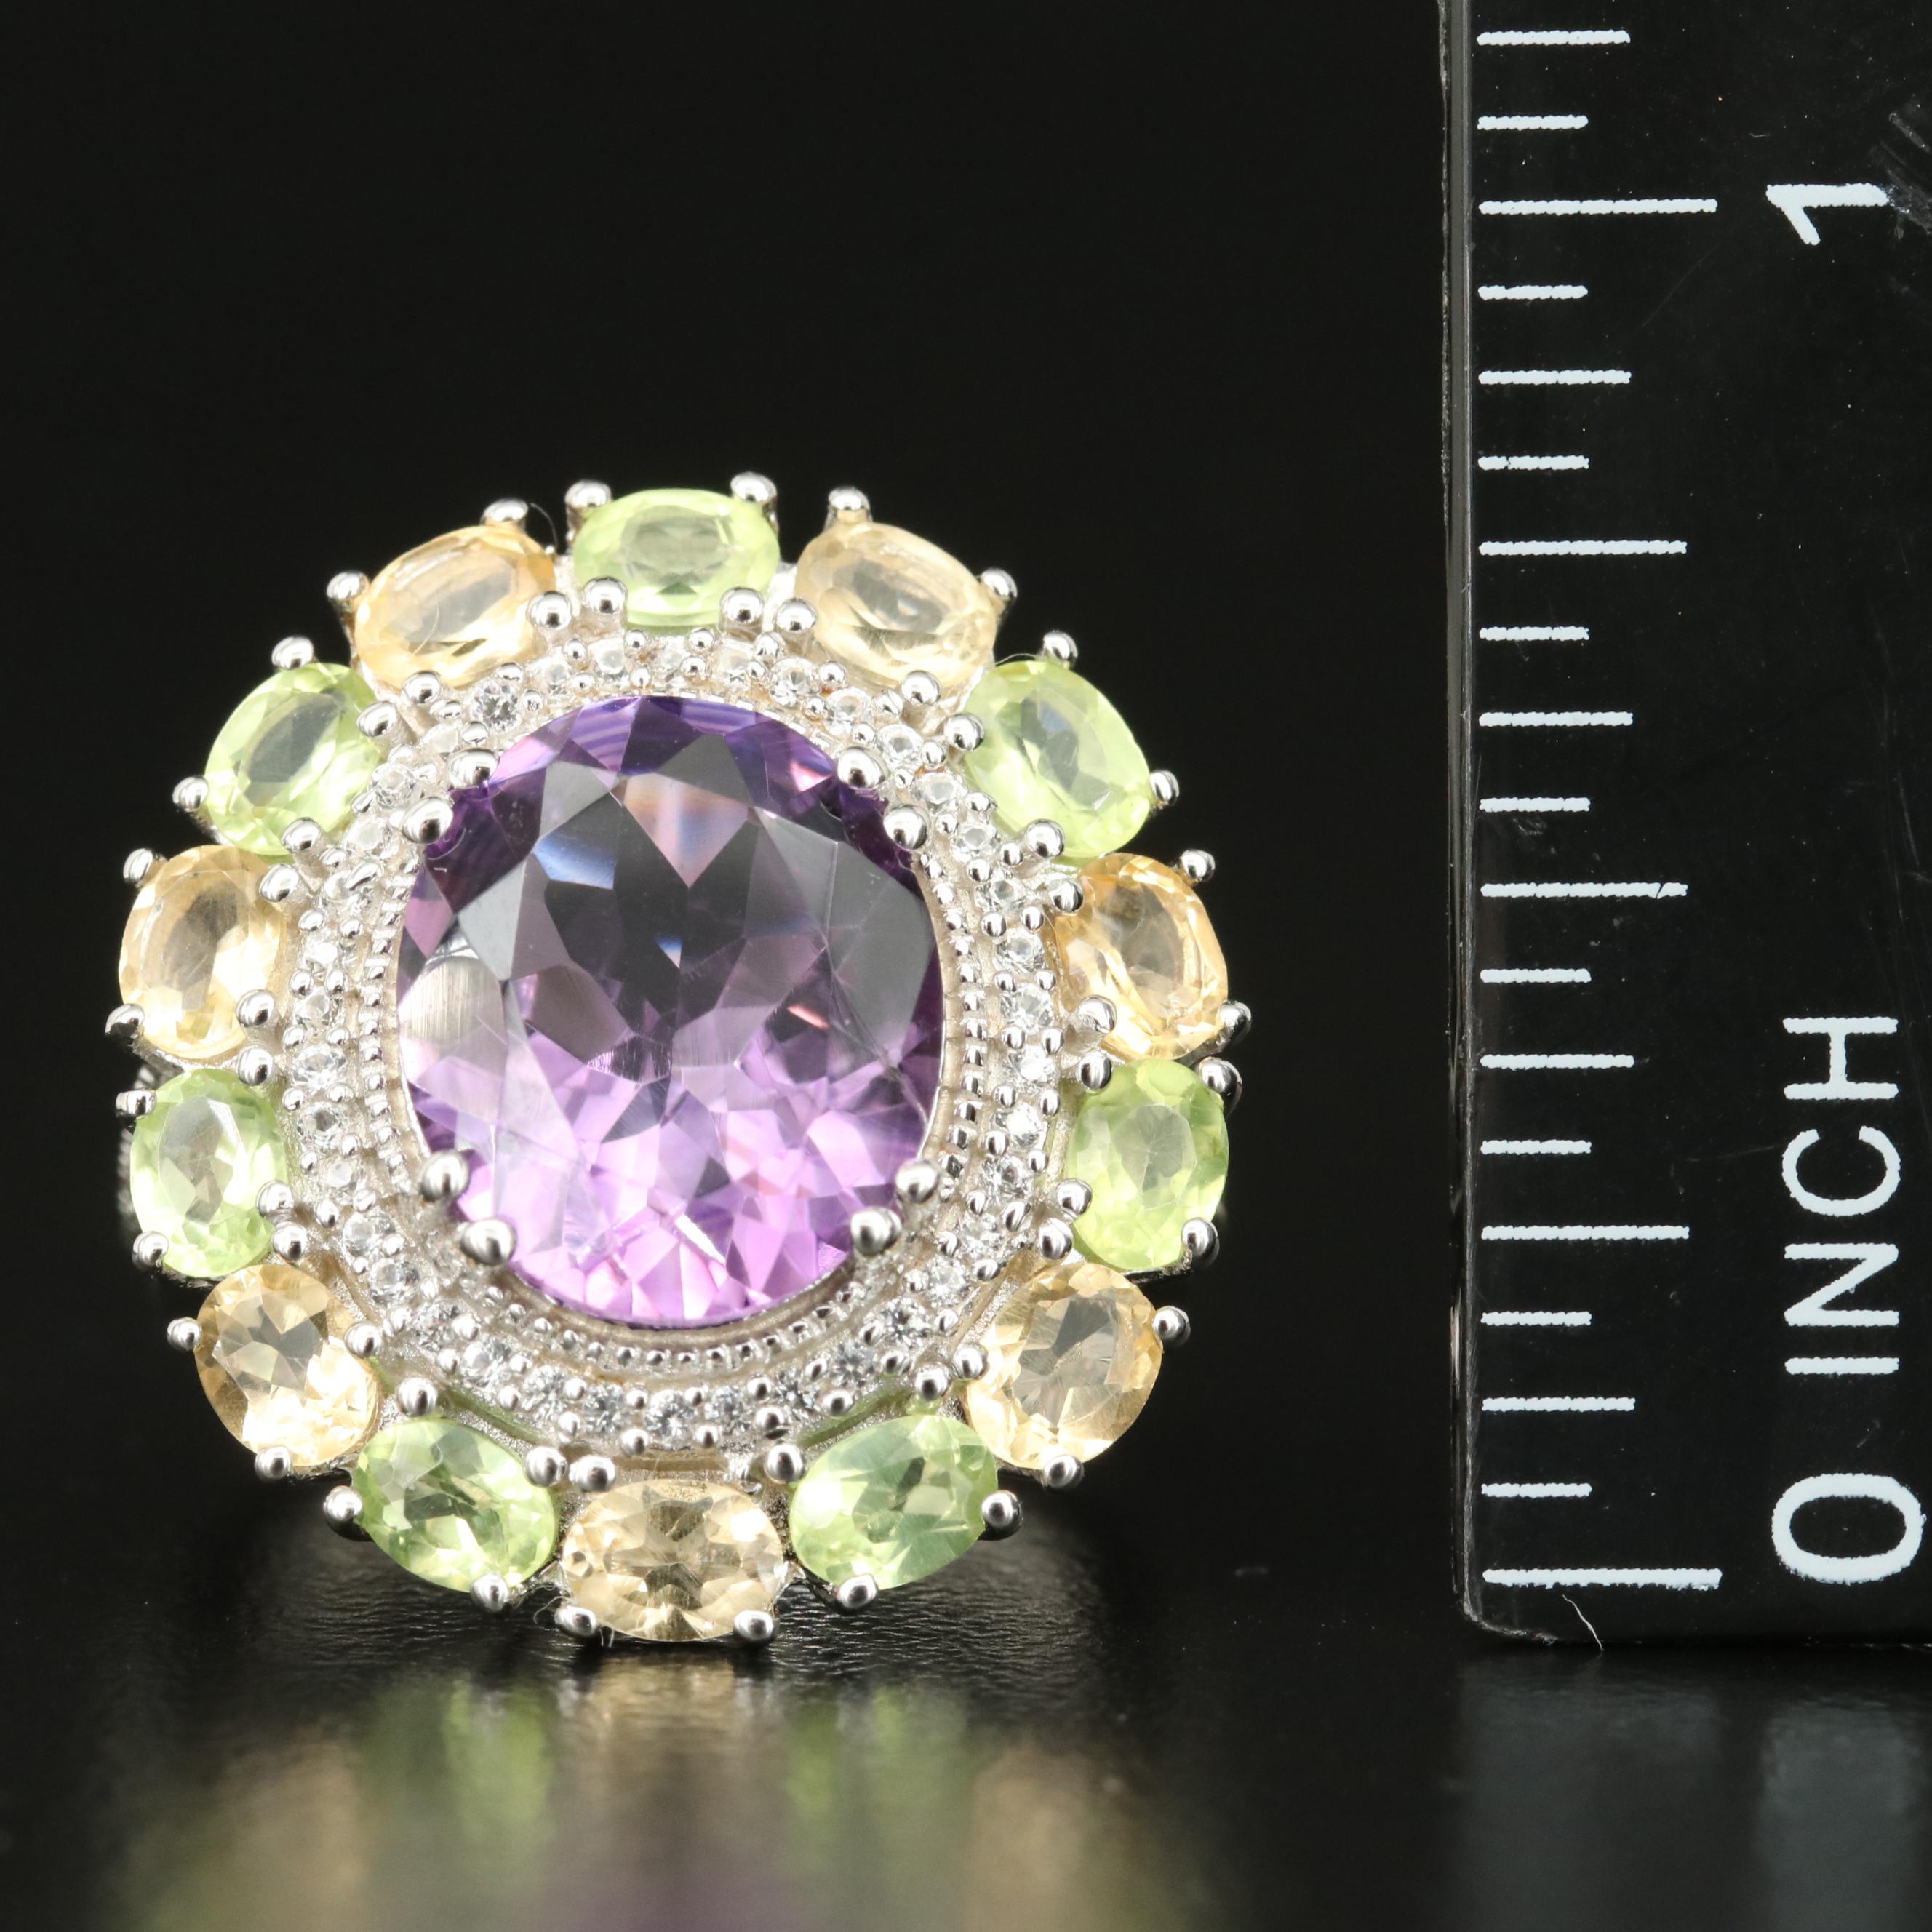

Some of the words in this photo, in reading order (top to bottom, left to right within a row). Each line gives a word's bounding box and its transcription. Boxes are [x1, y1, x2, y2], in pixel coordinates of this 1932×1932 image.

[1765, 182, 1891, 246] 1
[1781, 1015, 1902, 1376] INCH
[1771, 1472, 1927, 1586] 0
